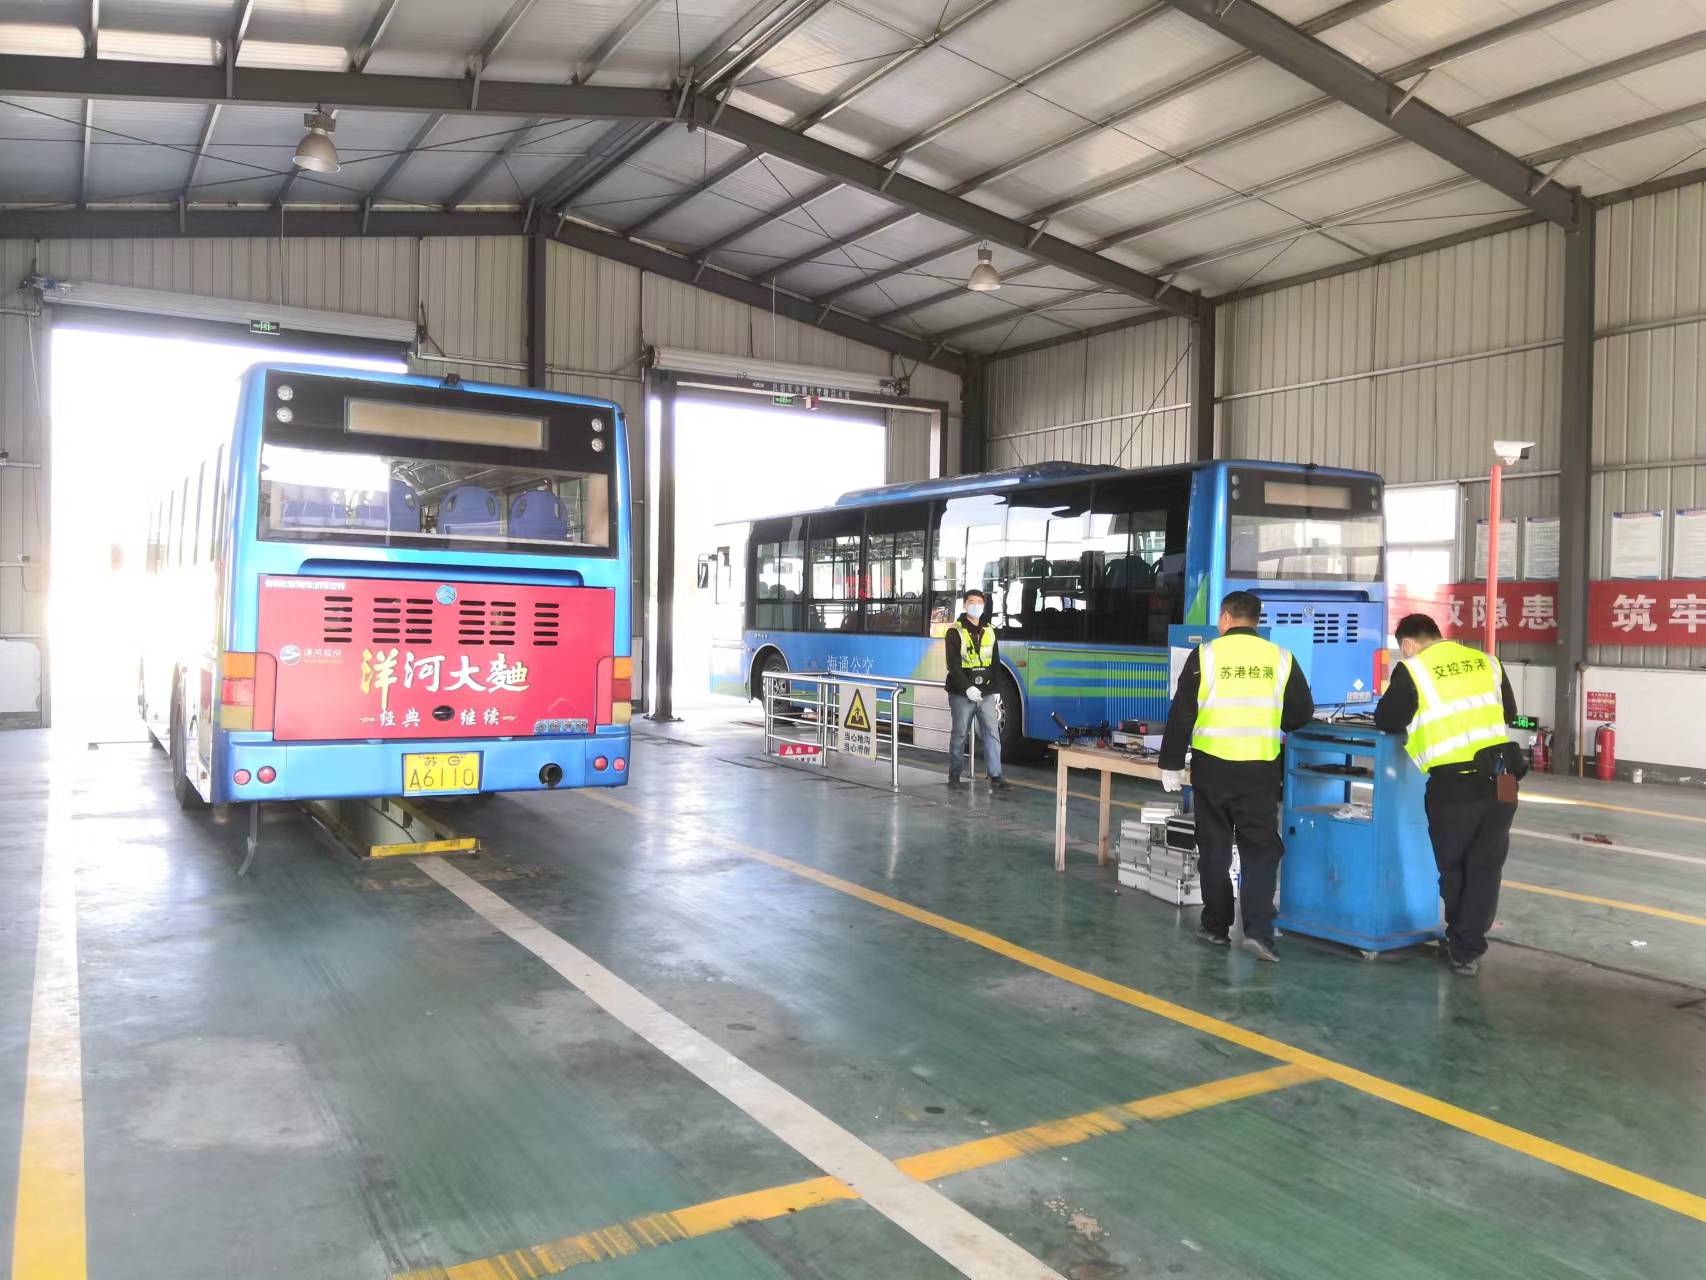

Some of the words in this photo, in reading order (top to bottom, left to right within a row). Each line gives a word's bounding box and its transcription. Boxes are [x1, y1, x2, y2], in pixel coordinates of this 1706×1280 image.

[1612, 593, 1706, 633] 筑牢
[827, 655, 874, 677] 海通公交
[1220, 666, 1274, 680] 苏港检测
[379, 708, 421, 727] 经典
[460, 708, 500, 726] 继续
[409, 768, 474, 788] A6110
